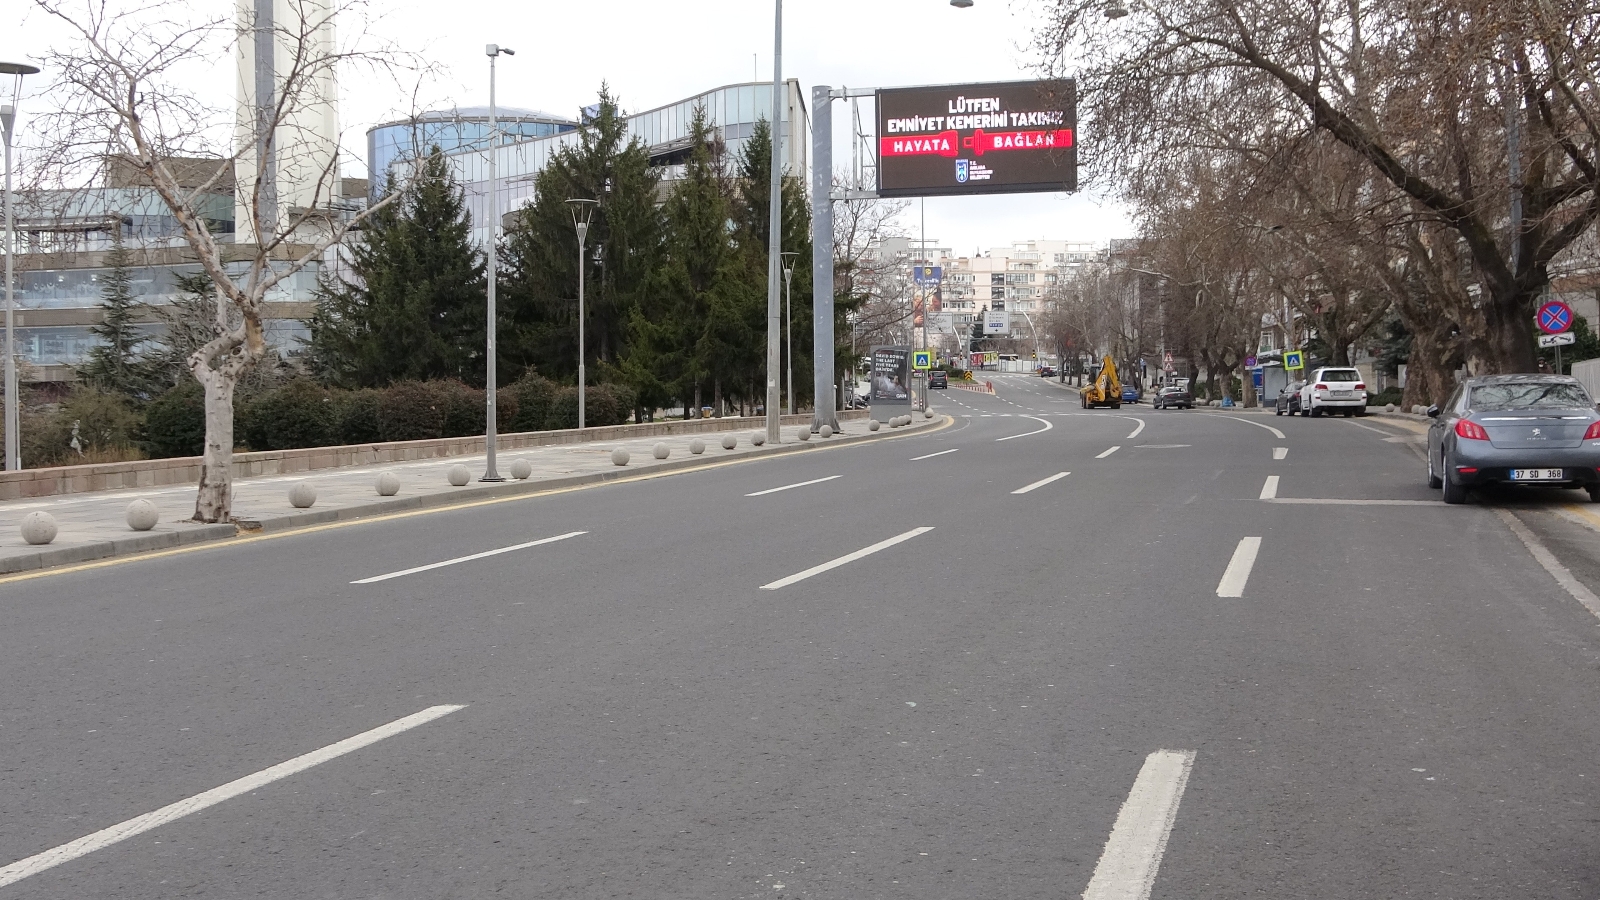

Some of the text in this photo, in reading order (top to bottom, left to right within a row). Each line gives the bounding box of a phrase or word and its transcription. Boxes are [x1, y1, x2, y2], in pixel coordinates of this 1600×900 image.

[948, 96, 1000, 114] LÜTFEN
[887, 115, 945, 133] EMNİYET
[946, 110, 1008, 130] KEMERİNİ
[893, 132, 1054, 153] HAYATA BAĞLAN
[1515, 470, 1524, 478] 37
[1547, 470, 1561, 478] 368
